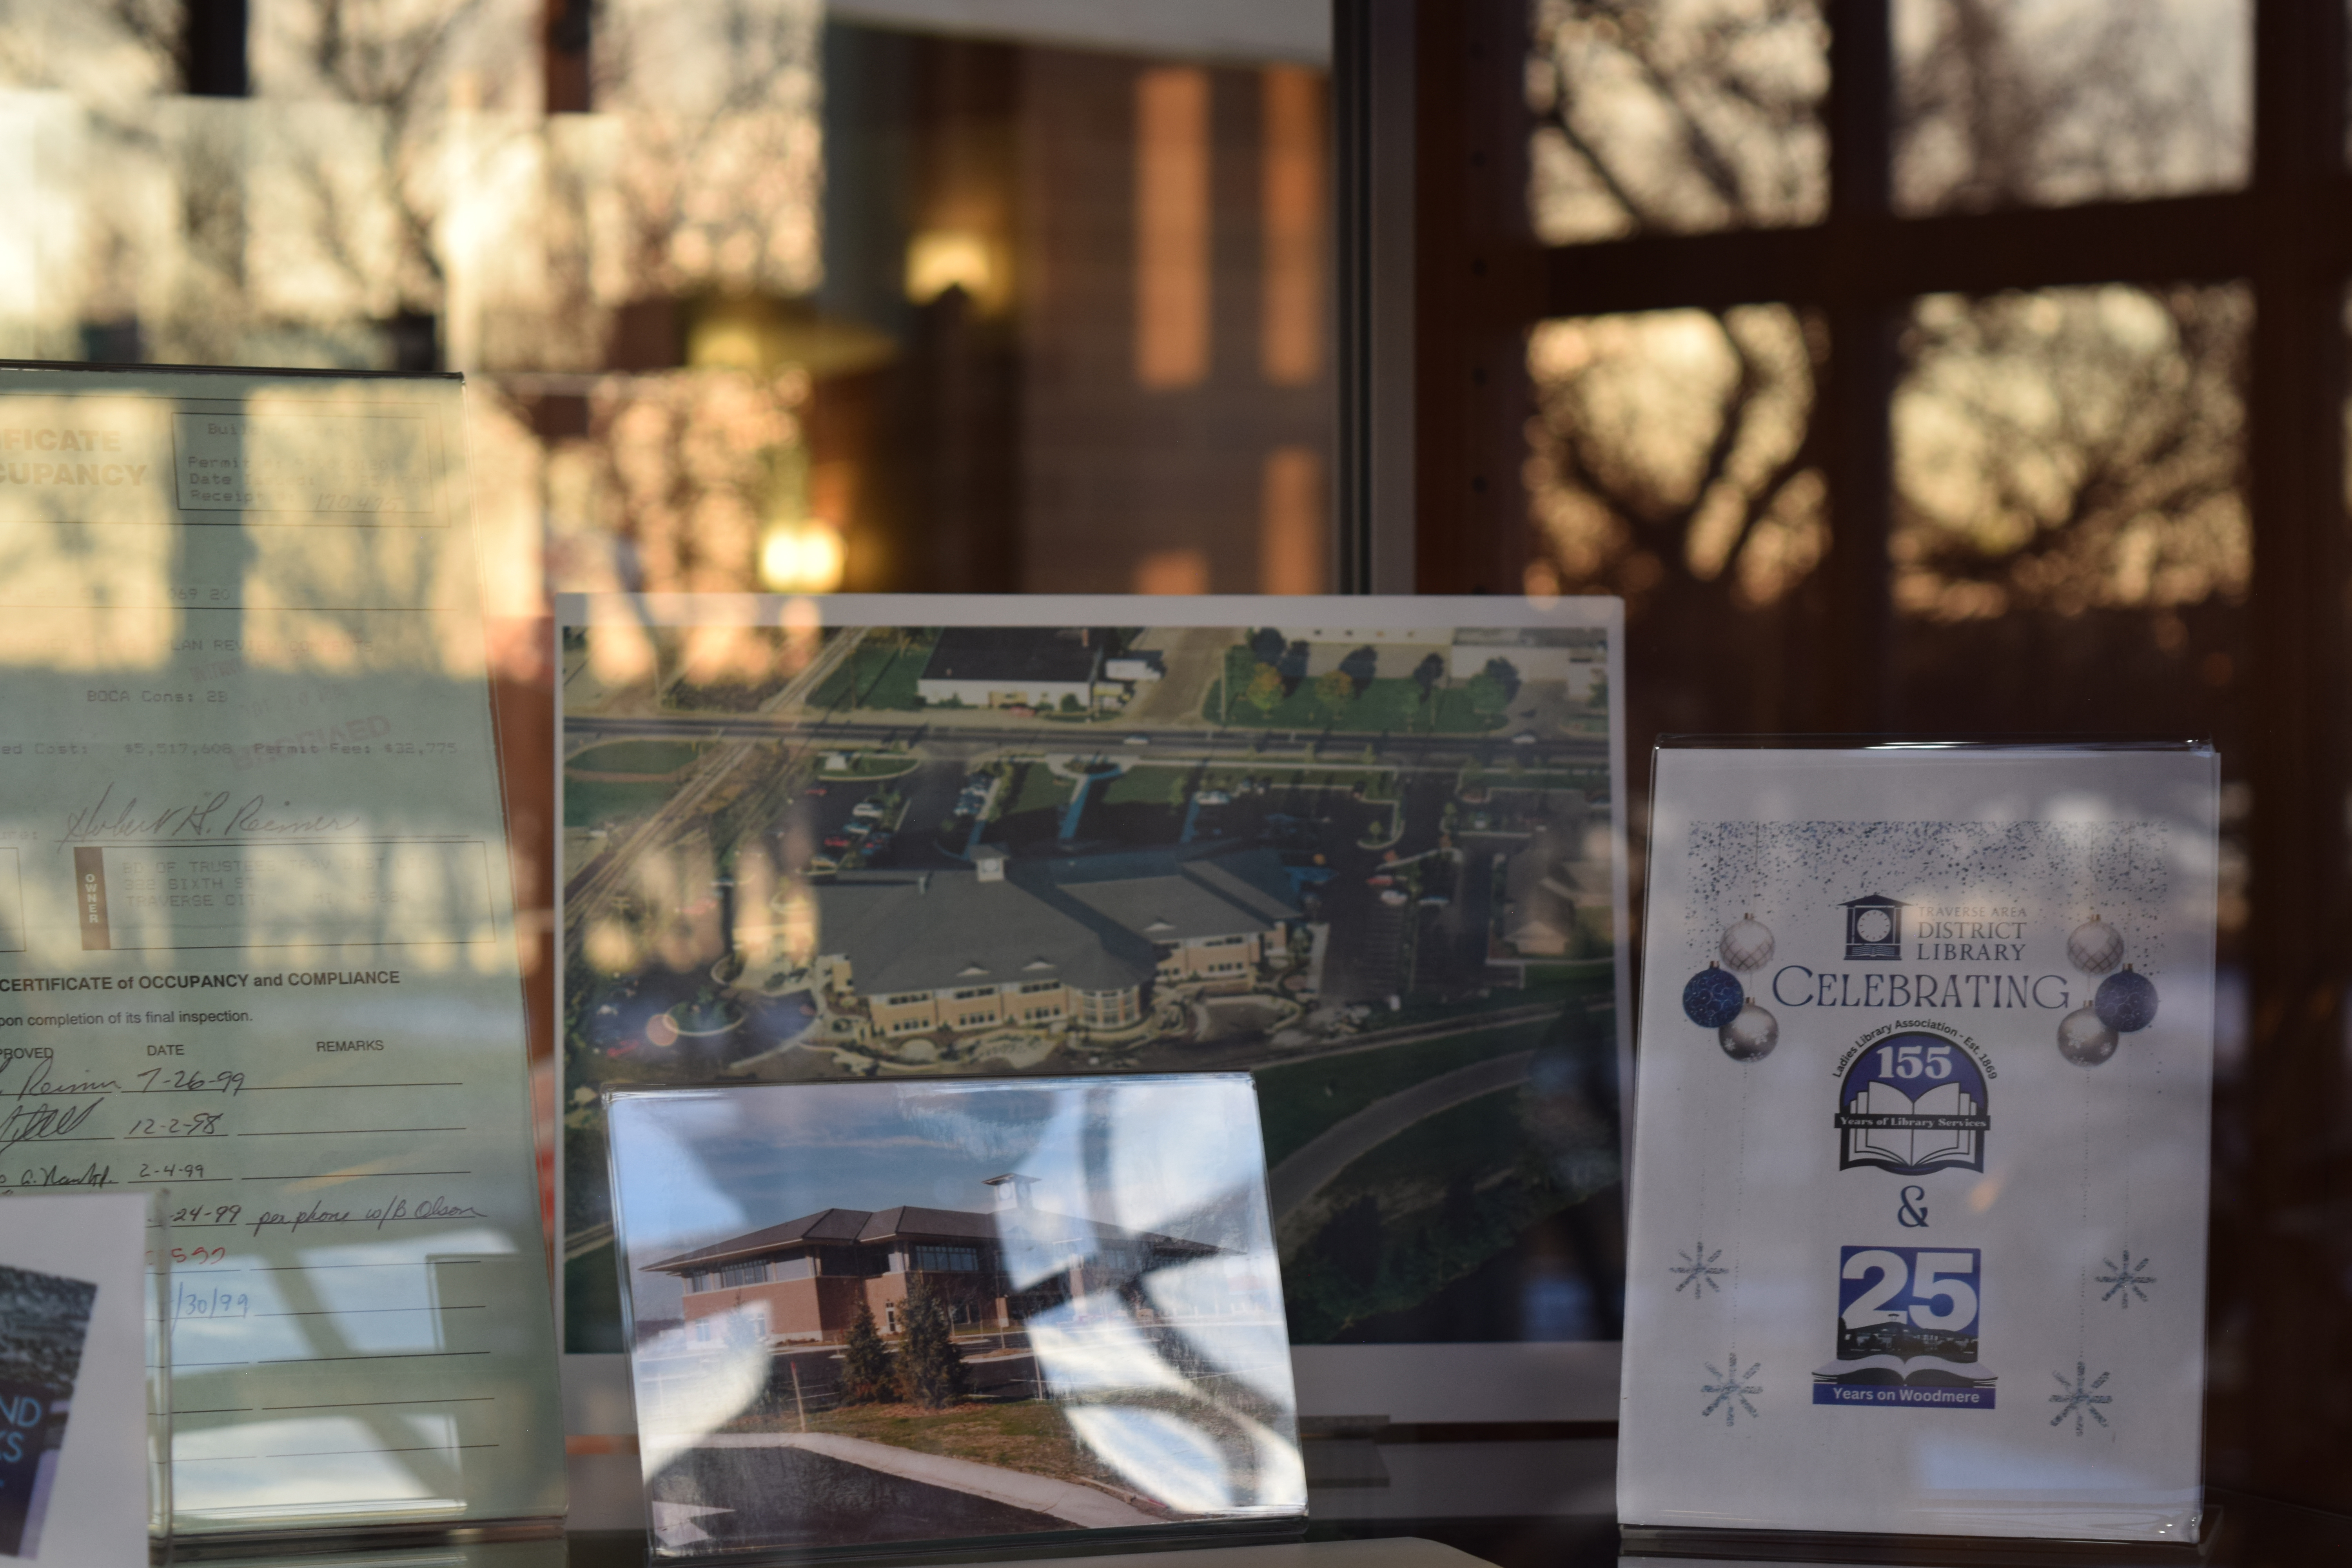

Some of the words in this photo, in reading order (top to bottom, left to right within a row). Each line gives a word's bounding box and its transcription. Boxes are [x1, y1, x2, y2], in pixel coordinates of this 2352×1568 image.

[188, 456, 250, 468] Permit
[189, 473, 232, 485] Date
[191, 489, 264, 503] Receipt
[160, 639, 203, 651] PLAN
[87, 690, 131, 702] BOCA
[141, 690, 194, 702] Cons:
[34, 742, 88, 755] Cost:
[253, 742, 319, 755] Permit
[330, 742, 370, 755] Fee:
[168, 878, 223, 890] SIXTH
[85, 873, 98, 923] OWNER
[126, 895, 214, 907] TRAVERSE
[1918, 906, 1986, 918] TRAVERSE
[1991, 907, 2028, 918] AREA
[1918, 921, 2027, 940] DISTRICT
[1916, 943, 2026, 961] LIBRARY
[0, 976, 113, 992] CERTIFICATE
[117, 976, 134, 989] of
[138, 974, 249, 989] OCCUPANCY
[254, 973, 283, 986] and
[288, 971, 400, 986] COMPLIANCE
[27, 1013, 104, 1028] completion
[109, 1012, 122, 1024] of
[126, 1012, 142, 1024] its
[145, 1011, 174, 1023] final
[179, 1009, 253, 1025] inspection.
[147, 1044, 184, 1056] DATE
[316, 1040, 385, 1052] REMARKS
[1831, 1047, 1858, 1079] Ladies
[1855, 1022, 1893, 1048] Library
[1894, 1018, 1958, 1037] Association
[1963, 1036, 1979, 1055] Est.
[1978, 1053, 1998, 1080] 1869
[1876, 1045, 1953, 1079] 155
[1840, 1116, 1874, 1126] Years
[1876, 1117, 1889, 1126] of
[1891, 1117, 1935, 1128] Library
[1938, 1118, 1987, 1127] Services
[139, 1163, 204, 1179] 2-4-99
[1897, 1185, 1929, 1228] &
[1842, 1250, 1978, 1332] 25
[1833, 1387, 1873, 1400] Years
[1877, 1390, 1896, 1401] on
[1899, 1388, 1980, 1403] Woodmere
